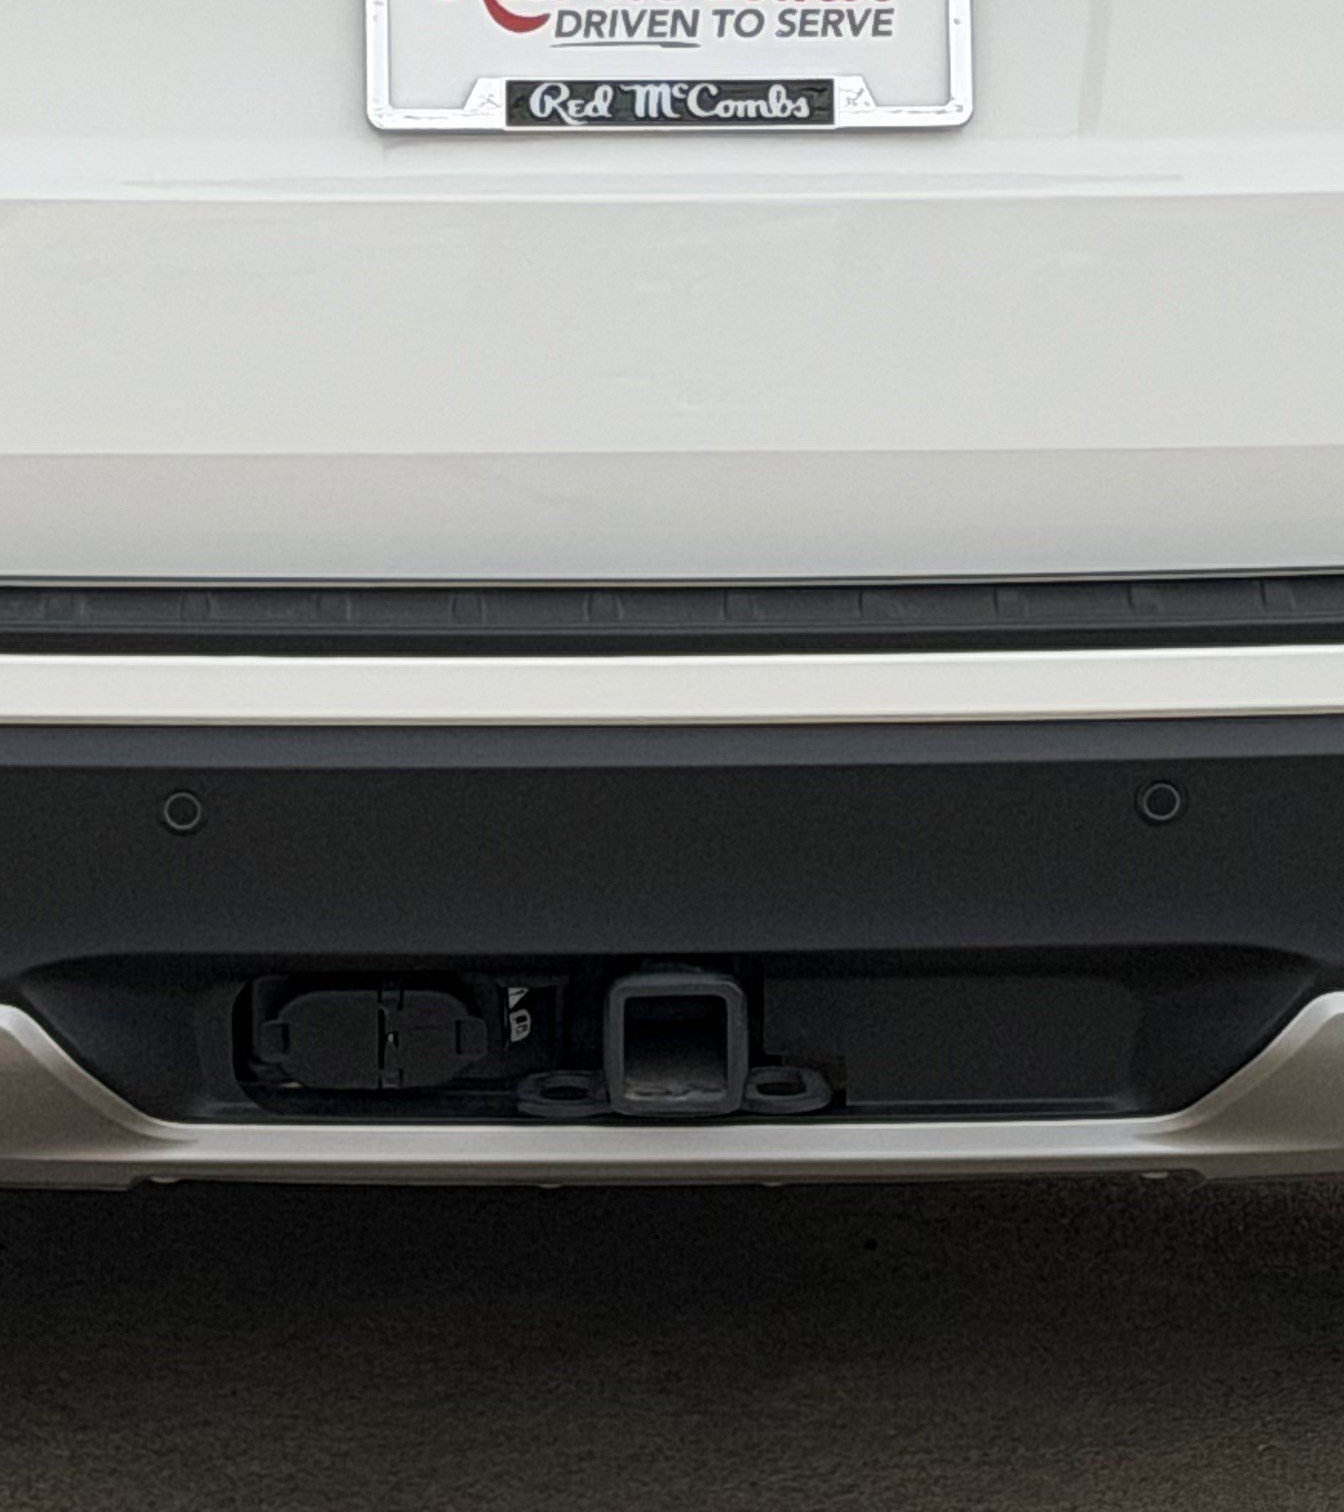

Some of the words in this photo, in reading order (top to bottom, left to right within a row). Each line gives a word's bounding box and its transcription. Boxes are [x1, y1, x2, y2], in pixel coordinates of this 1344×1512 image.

[555, 8, 700, 39] DRIVEN
[712, 8, 765, 38] TO
[776, 8, 895, 38] SERVE
[529, 82, 614, 125] Red
[619, 82, 810, 119] McCombs
